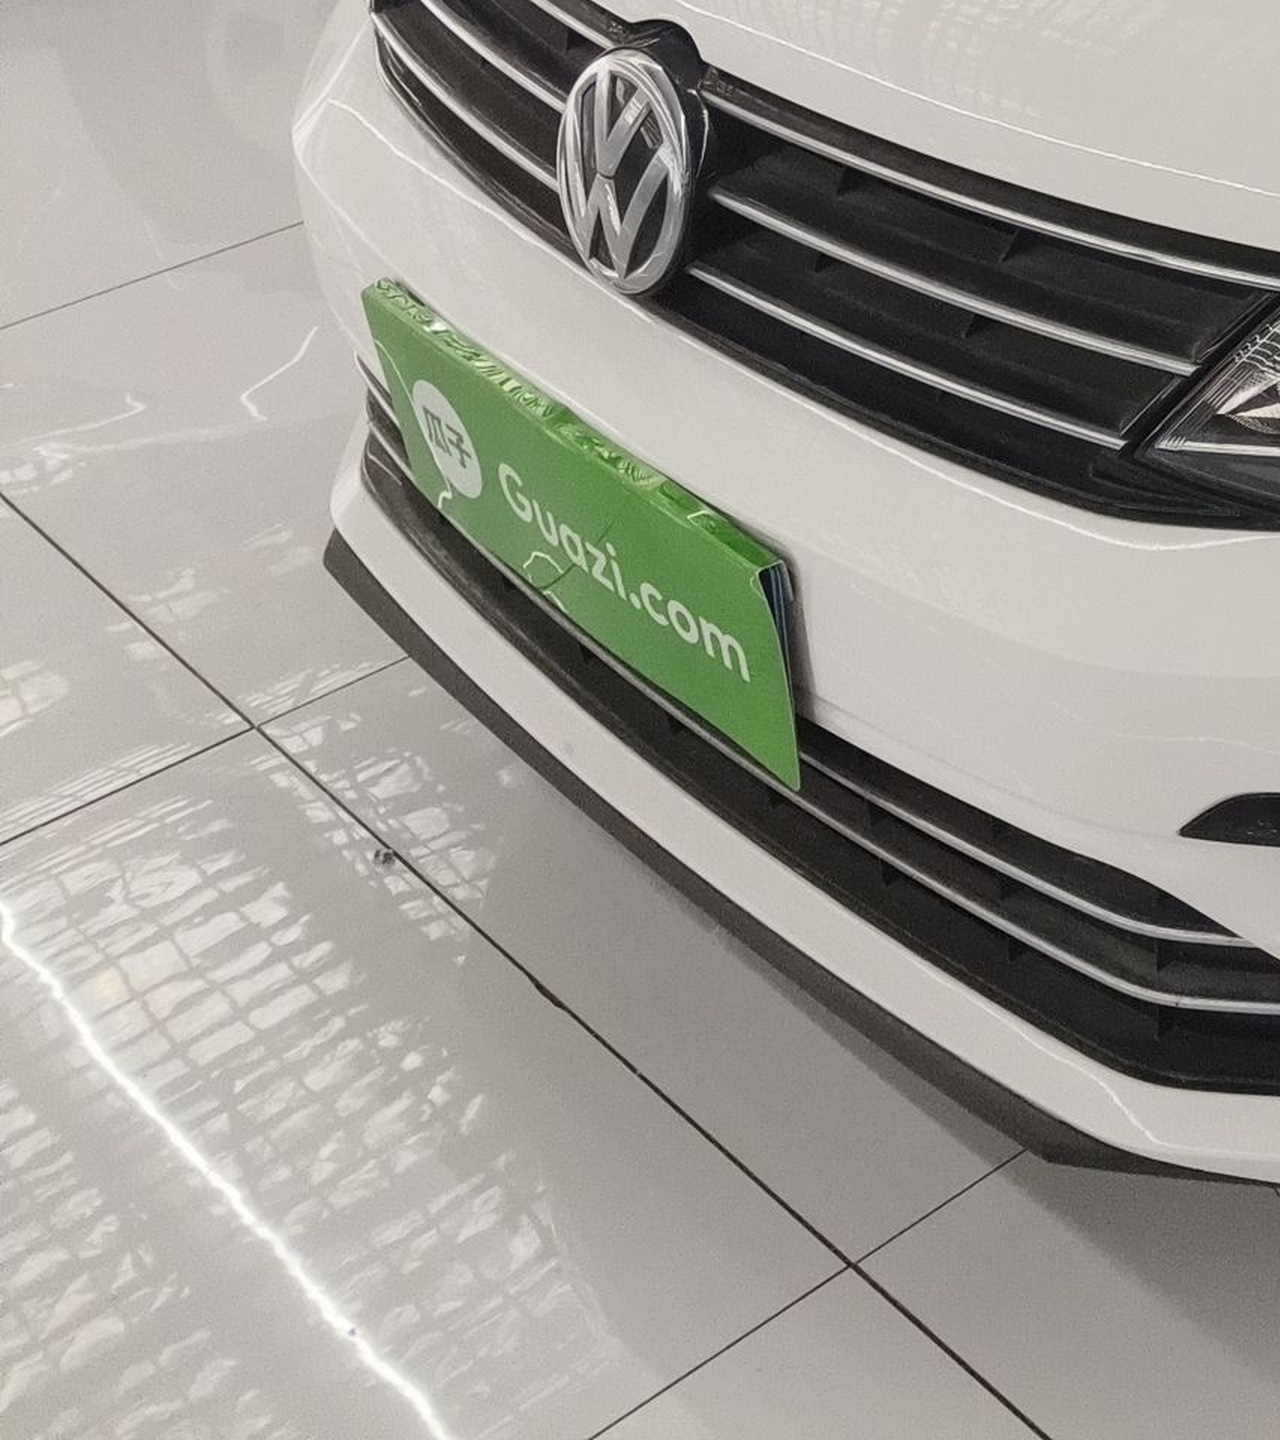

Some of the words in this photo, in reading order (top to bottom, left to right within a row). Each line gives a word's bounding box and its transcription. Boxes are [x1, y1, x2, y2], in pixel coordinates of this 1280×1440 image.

[558, 50, 684, 292] VW
[422, 405, 472, 468] 瓜子
[498, 462, 750, 683] Guazi.com
